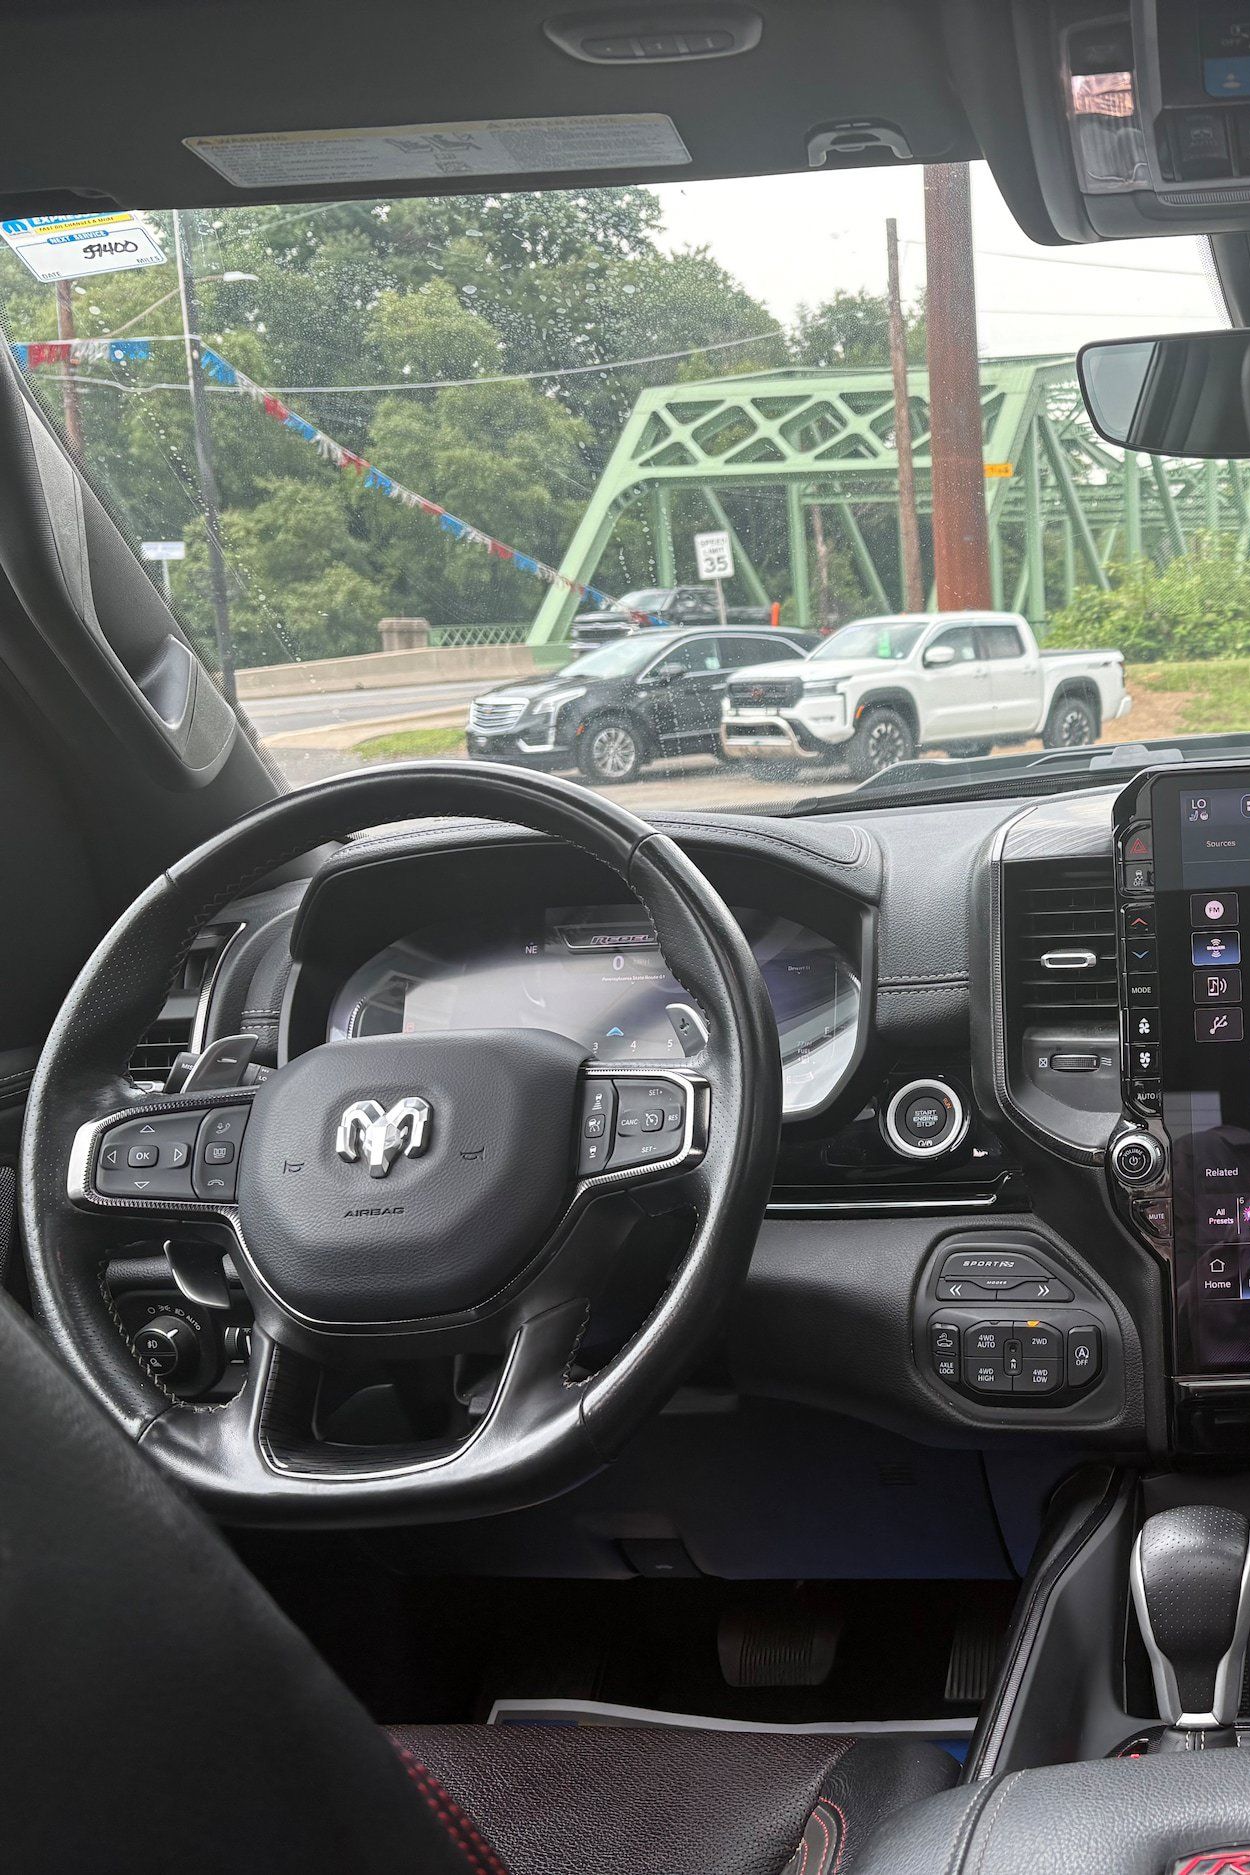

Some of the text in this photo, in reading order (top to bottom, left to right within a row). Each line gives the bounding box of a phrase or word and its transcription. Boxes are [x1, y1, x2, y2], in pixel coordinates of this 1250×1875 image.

[49, 230, 107, 244] NEXT SERVICE
[136, 256, 160, 264] MILES
[41, 271, 61, 279] DATE
[703, 555, 729, 573] 35
[1191, 798, 1207, 809] LO
[1206, 839, 1236, 848] Sources
[525, 946, 538, 954] NE
[612, 955, 625, 971] 0
[1131, 986, 1152, 994] MODE
[630, 1040, 637, 1049] 4
[667, 1039, 673, 1048] 5
[1137, 1092, 1155, 1101] AUTO
[621, 1118, 639, 1127] CANC
[668, 1114, 679, 1122] RES
[136, 1151, 150, 1161] OK
[1123, 1148, 1143, 1157] VOLUME
[1205, 1167, 1239, 1177] Related
[1239, 1196, 1245, 1204] 6
[344, 1206, 405, 1218] AIRBAG
[1216, 1208, 1226, 1216] All
[1208, 1217, 1234, 1226] Presets
[962, 1260, 999, 1268] SPORT
[1204, 1280, 1232, 1289] Home
[185, 1315, 201, 1331] AUTO
[978, 1334, 995, 1342] 4WD
[977, 1341, 996, 1349] AUTO
